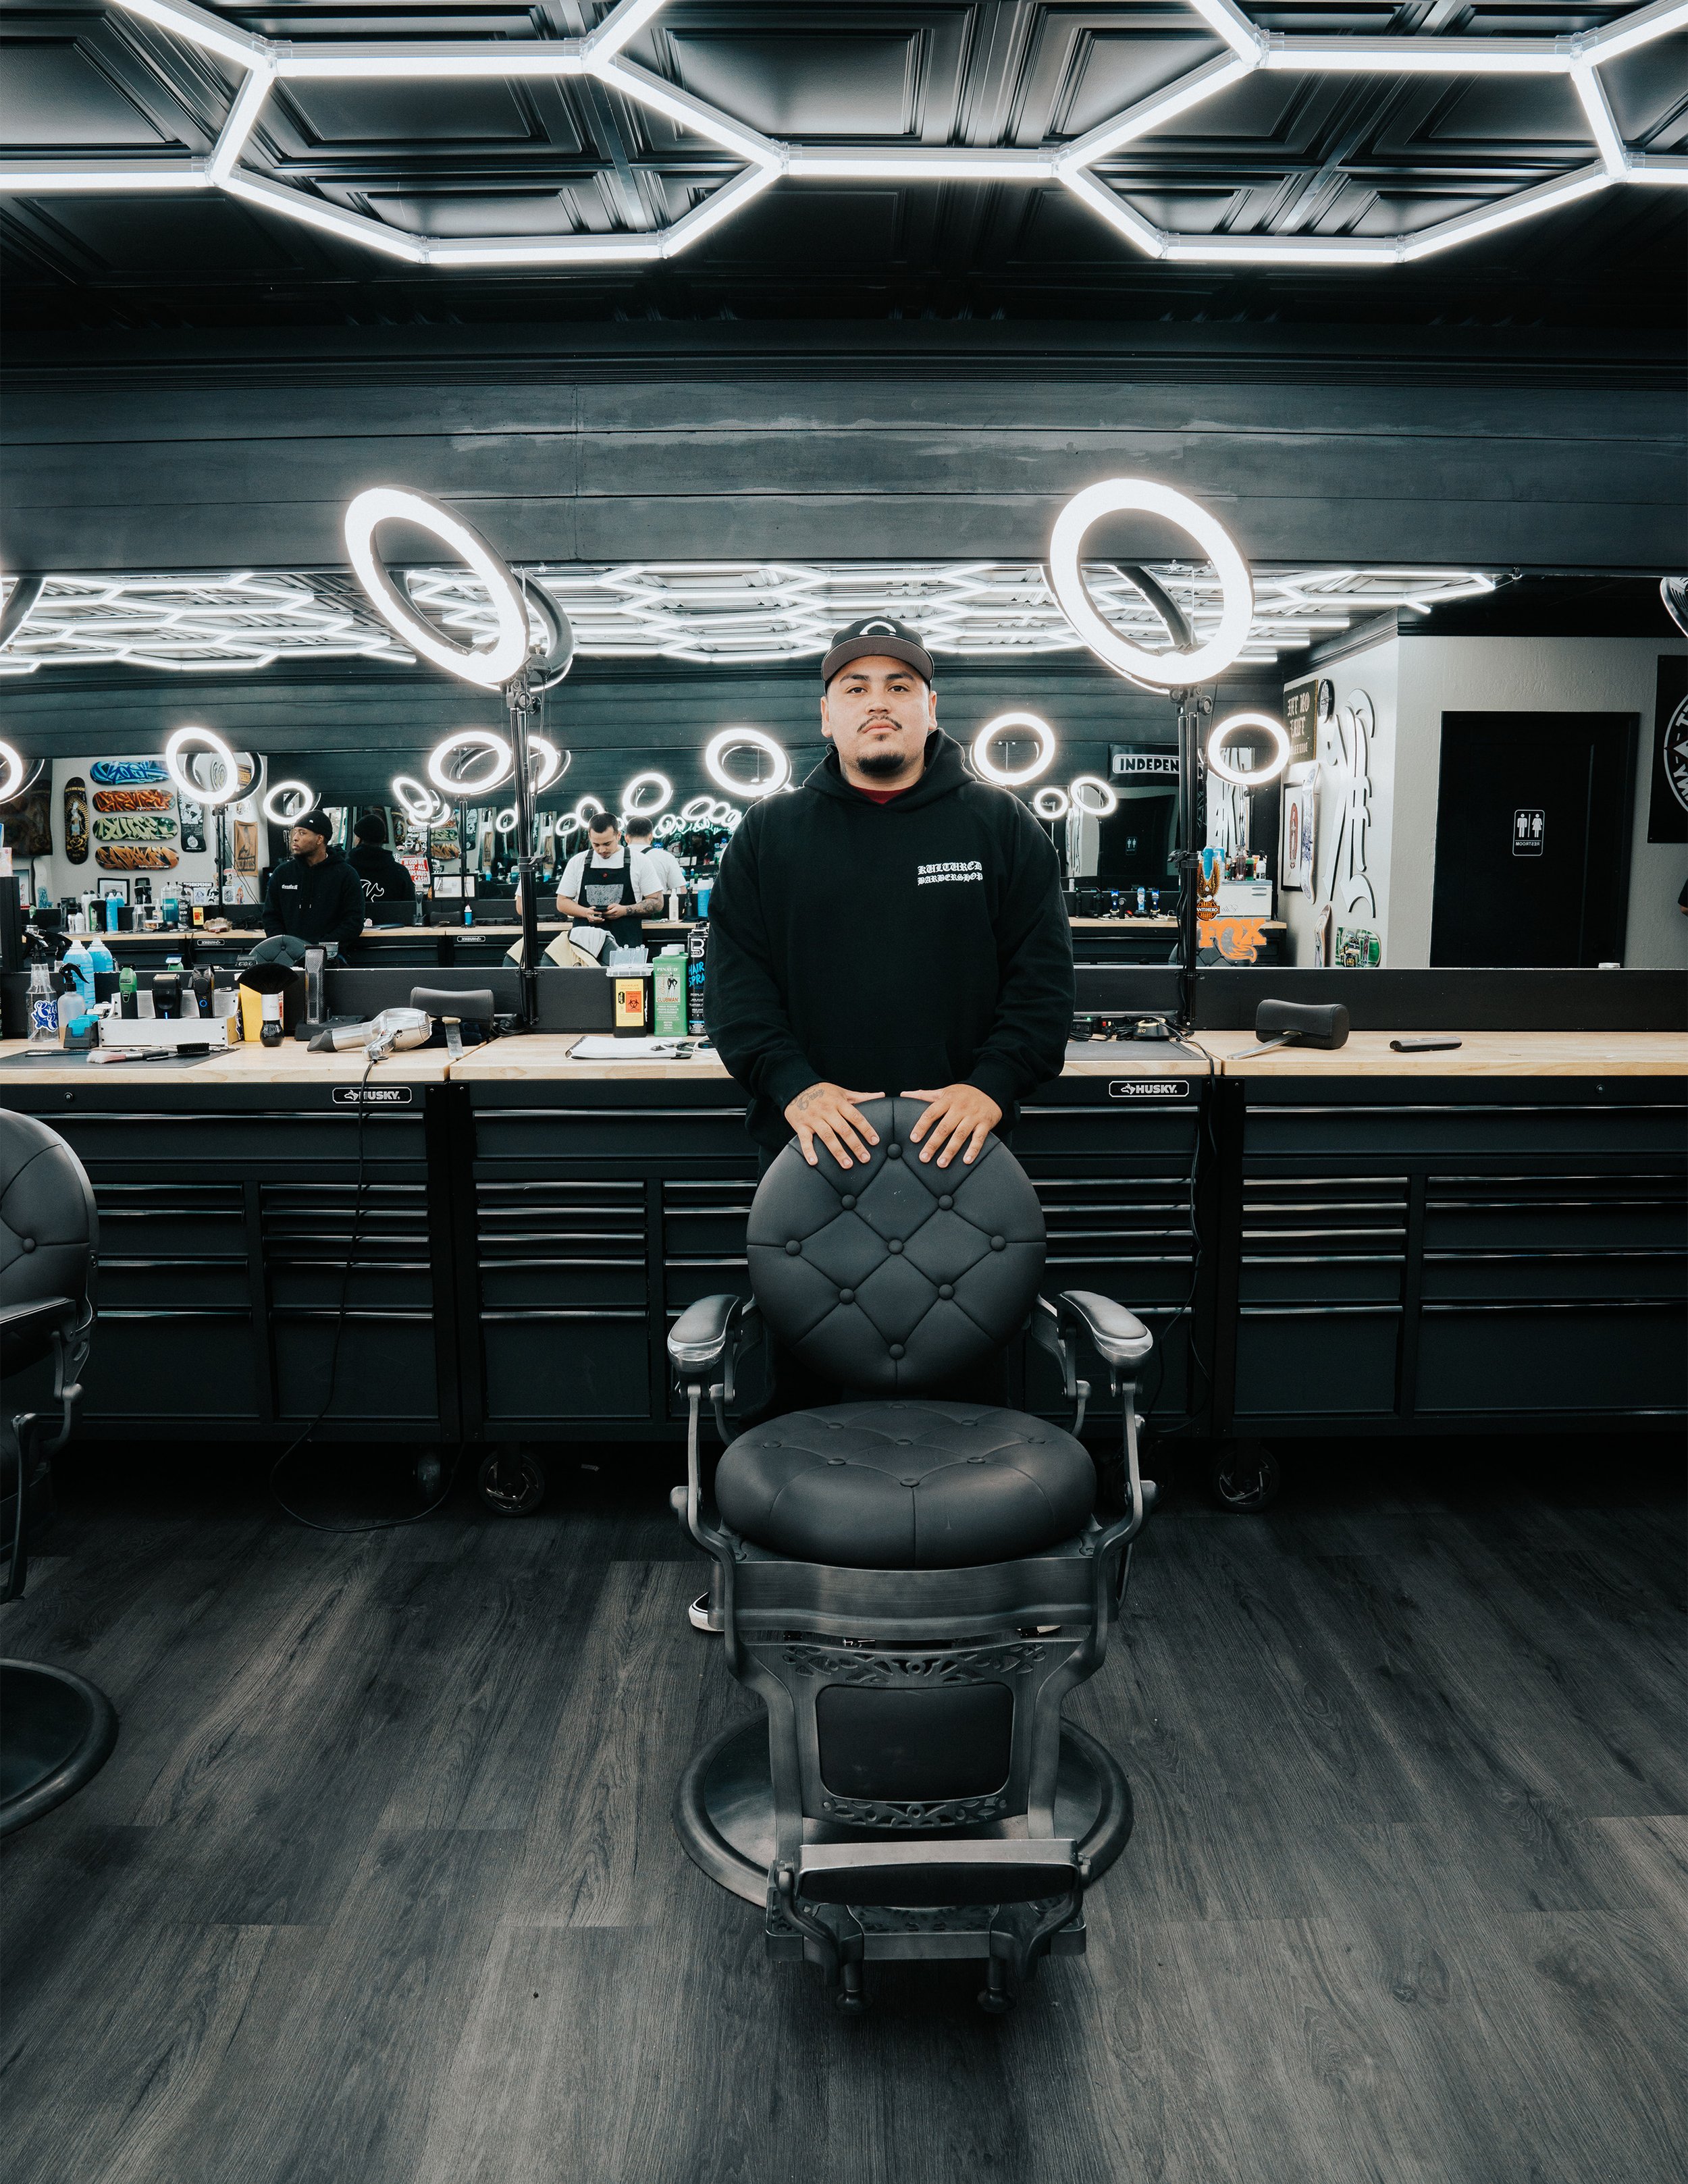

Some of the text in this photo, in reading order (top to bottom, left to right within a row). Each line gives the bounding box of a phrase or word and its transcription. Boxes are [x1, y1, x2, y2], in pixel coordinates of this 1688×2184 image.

[918, 861, 982, 875] KULTURED
[918, 872, 983, 886] BARBERSHOP
[1198, 917, 1267, 963] FOX
[688, 961, 705, 976] HAIR
[689, 973, 705, 988] SPRA
